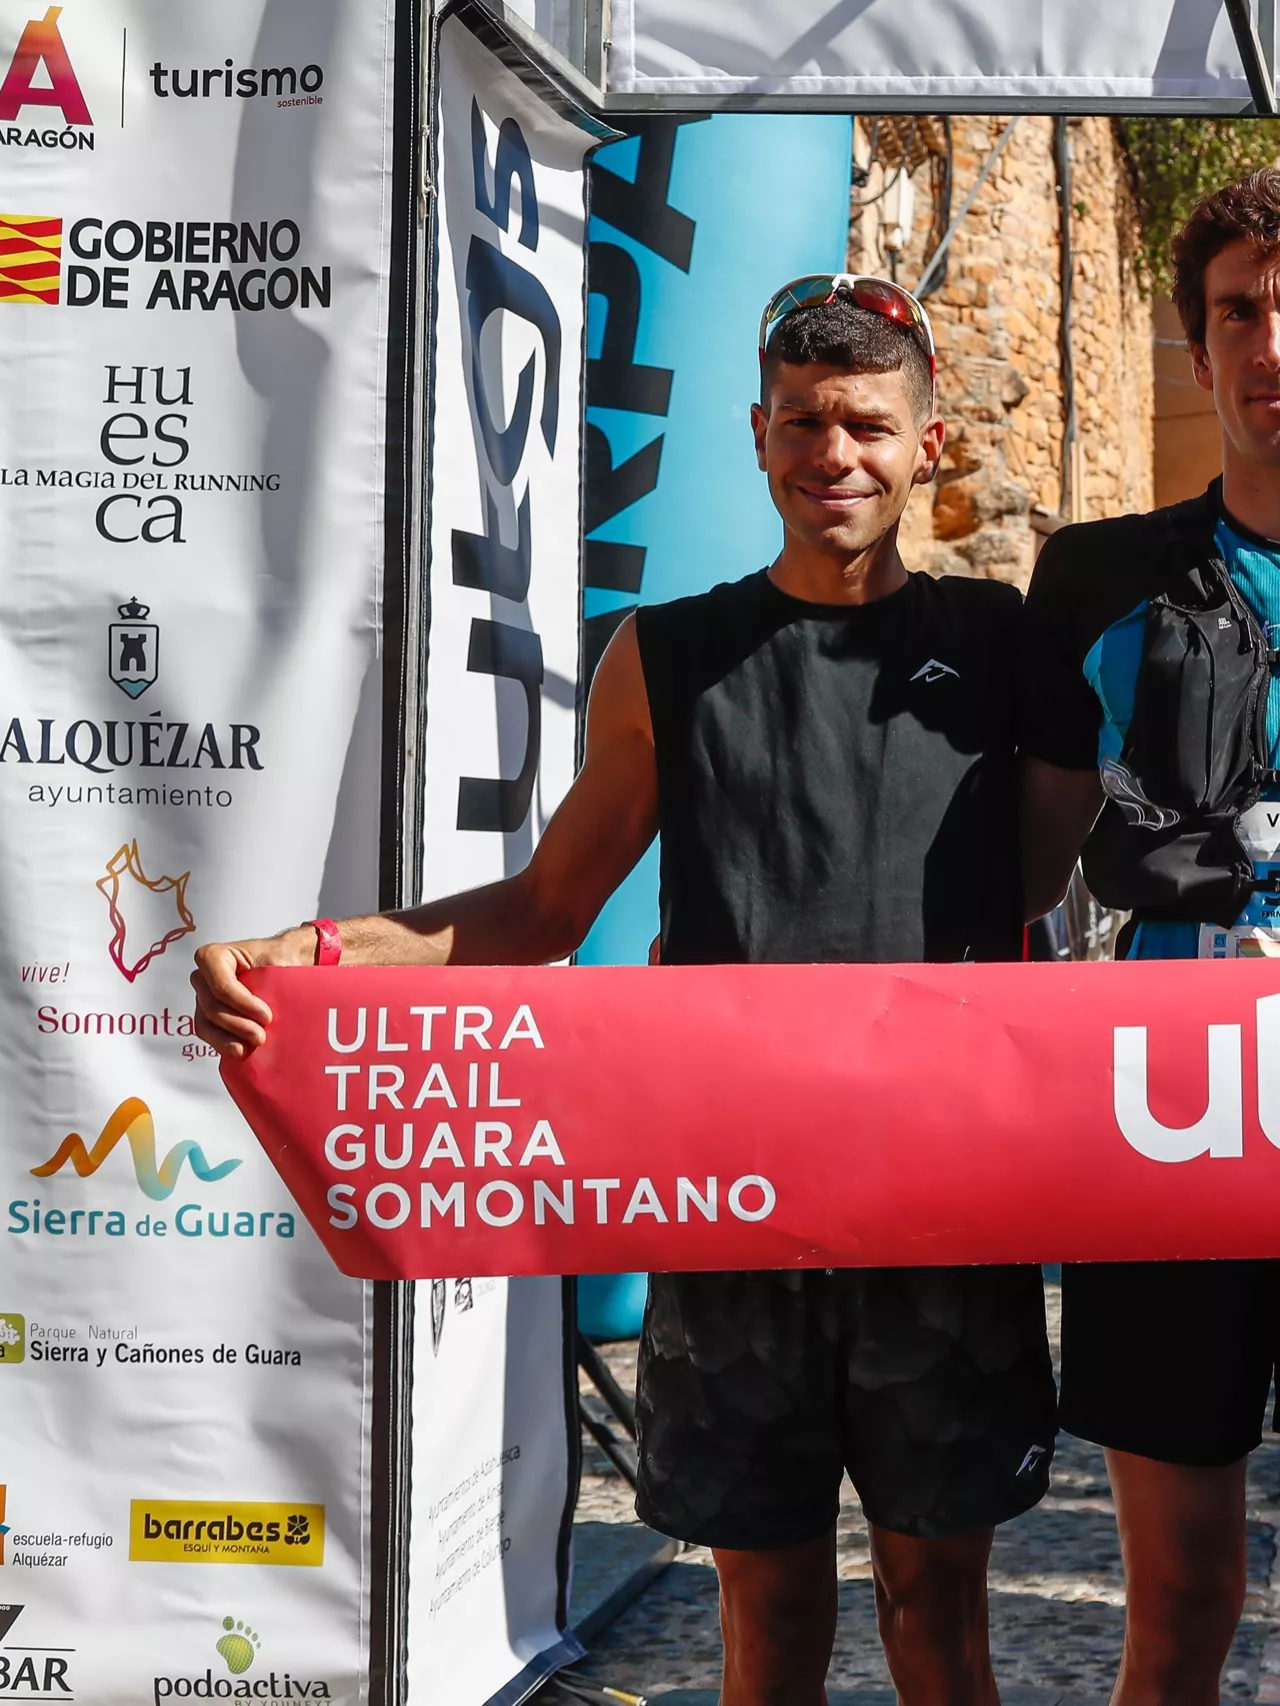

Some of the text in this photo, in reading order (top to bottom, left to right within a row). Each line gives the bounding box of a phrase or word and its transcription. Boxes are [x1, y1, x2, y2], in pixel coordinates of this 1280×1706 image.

[149, 58, 323, 98] turismo
[277, 96, 323, 108] sostenible
[69, 218, 300, 263] GOBIERNO
[66, 266, 332, 311] DE ARAGON
[583, 113, 711, 690] RPA
[100, 412, 190, 468] es
[450, 93, 562, 833] utgs
[95, 494, 187, 543] ca
[0, 711, 265, 773] ALQUÉZAR
[28, 783, 233, 808] ayuntamiento
[21, 962, 70, 984] vive!
[37, 1006, 195, 1037] Somonta
[325, 1004, 546, 1054] ULTRA
[181, 1043, 218, 1062] gua
[325, 1061, 522, 1112] TRAIL
[325, 1119, 566, 1171] GUARA
[7, 1199, 295, 1238] Sierra de Guara
[325, 1174, 777, 1230] SOMONTANO
[30, 1322, 76, 1342] Parque
[88, 1324, 138, 1340] Natural
[30, 1340, 89, 1362] Sierra
[96, 1346, 107, 1367] y
[115, 1342, 204, 1364] Cañones
[212, 1343, 237, 1364] de
[245, 1343, 301, 1366] Guara
[12, 1533, 114, 1550] escuela-refugio
[144, 1513, 281, 1543] barrabes
[12, 1552, 68, 1568] Alquézar
[183, 1542, 270, 1555] ESQUÍ Y MONTAÑA
[154, 1669, 331, 1706] podoactiva
